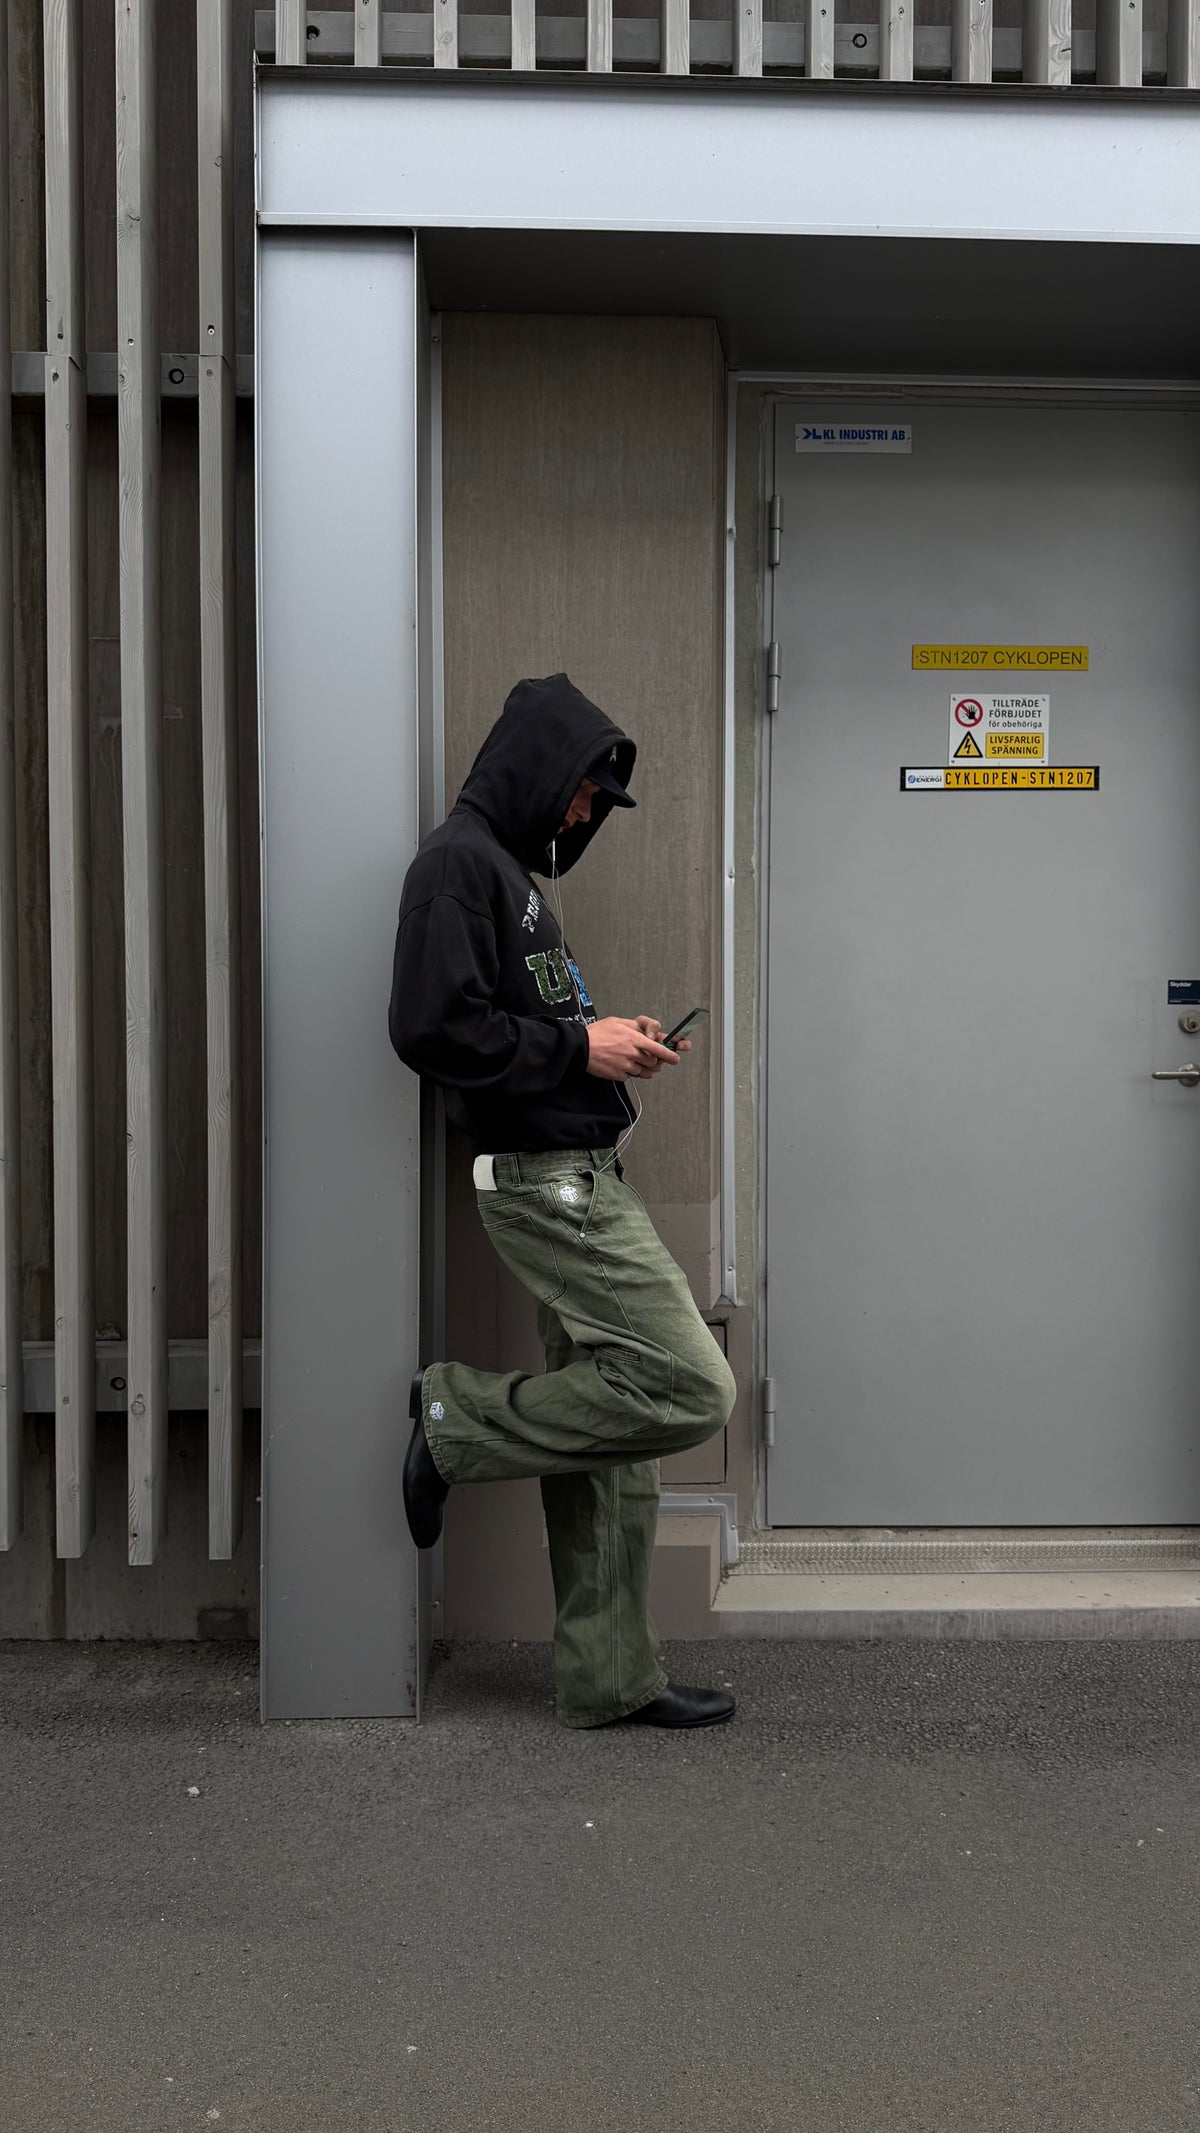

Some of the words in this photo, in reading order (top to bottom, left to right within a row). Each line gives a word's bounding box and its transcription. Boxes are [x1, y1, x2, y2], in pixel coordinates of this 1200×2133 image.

[823, 429, 836, 440] KL
[839, 429, 888, 440] INDUSTRI
[891, 430, 906, 440] AB
[919, 650, 988, 664] STN1207
[993, 651, 1082, 665] CYKLOPEN
[992, 697, 1039, 708] TILLTRÄDE
[989, 708, 1042, 718] FÖRBJUDET
[988, 720, 1000, 728] för
[1002, 720, 1042, 729] obehöriga
[989, 736, 1041, 744] LIVSFARLIG
[991, 745, 1038, 755] SPÄNNING
